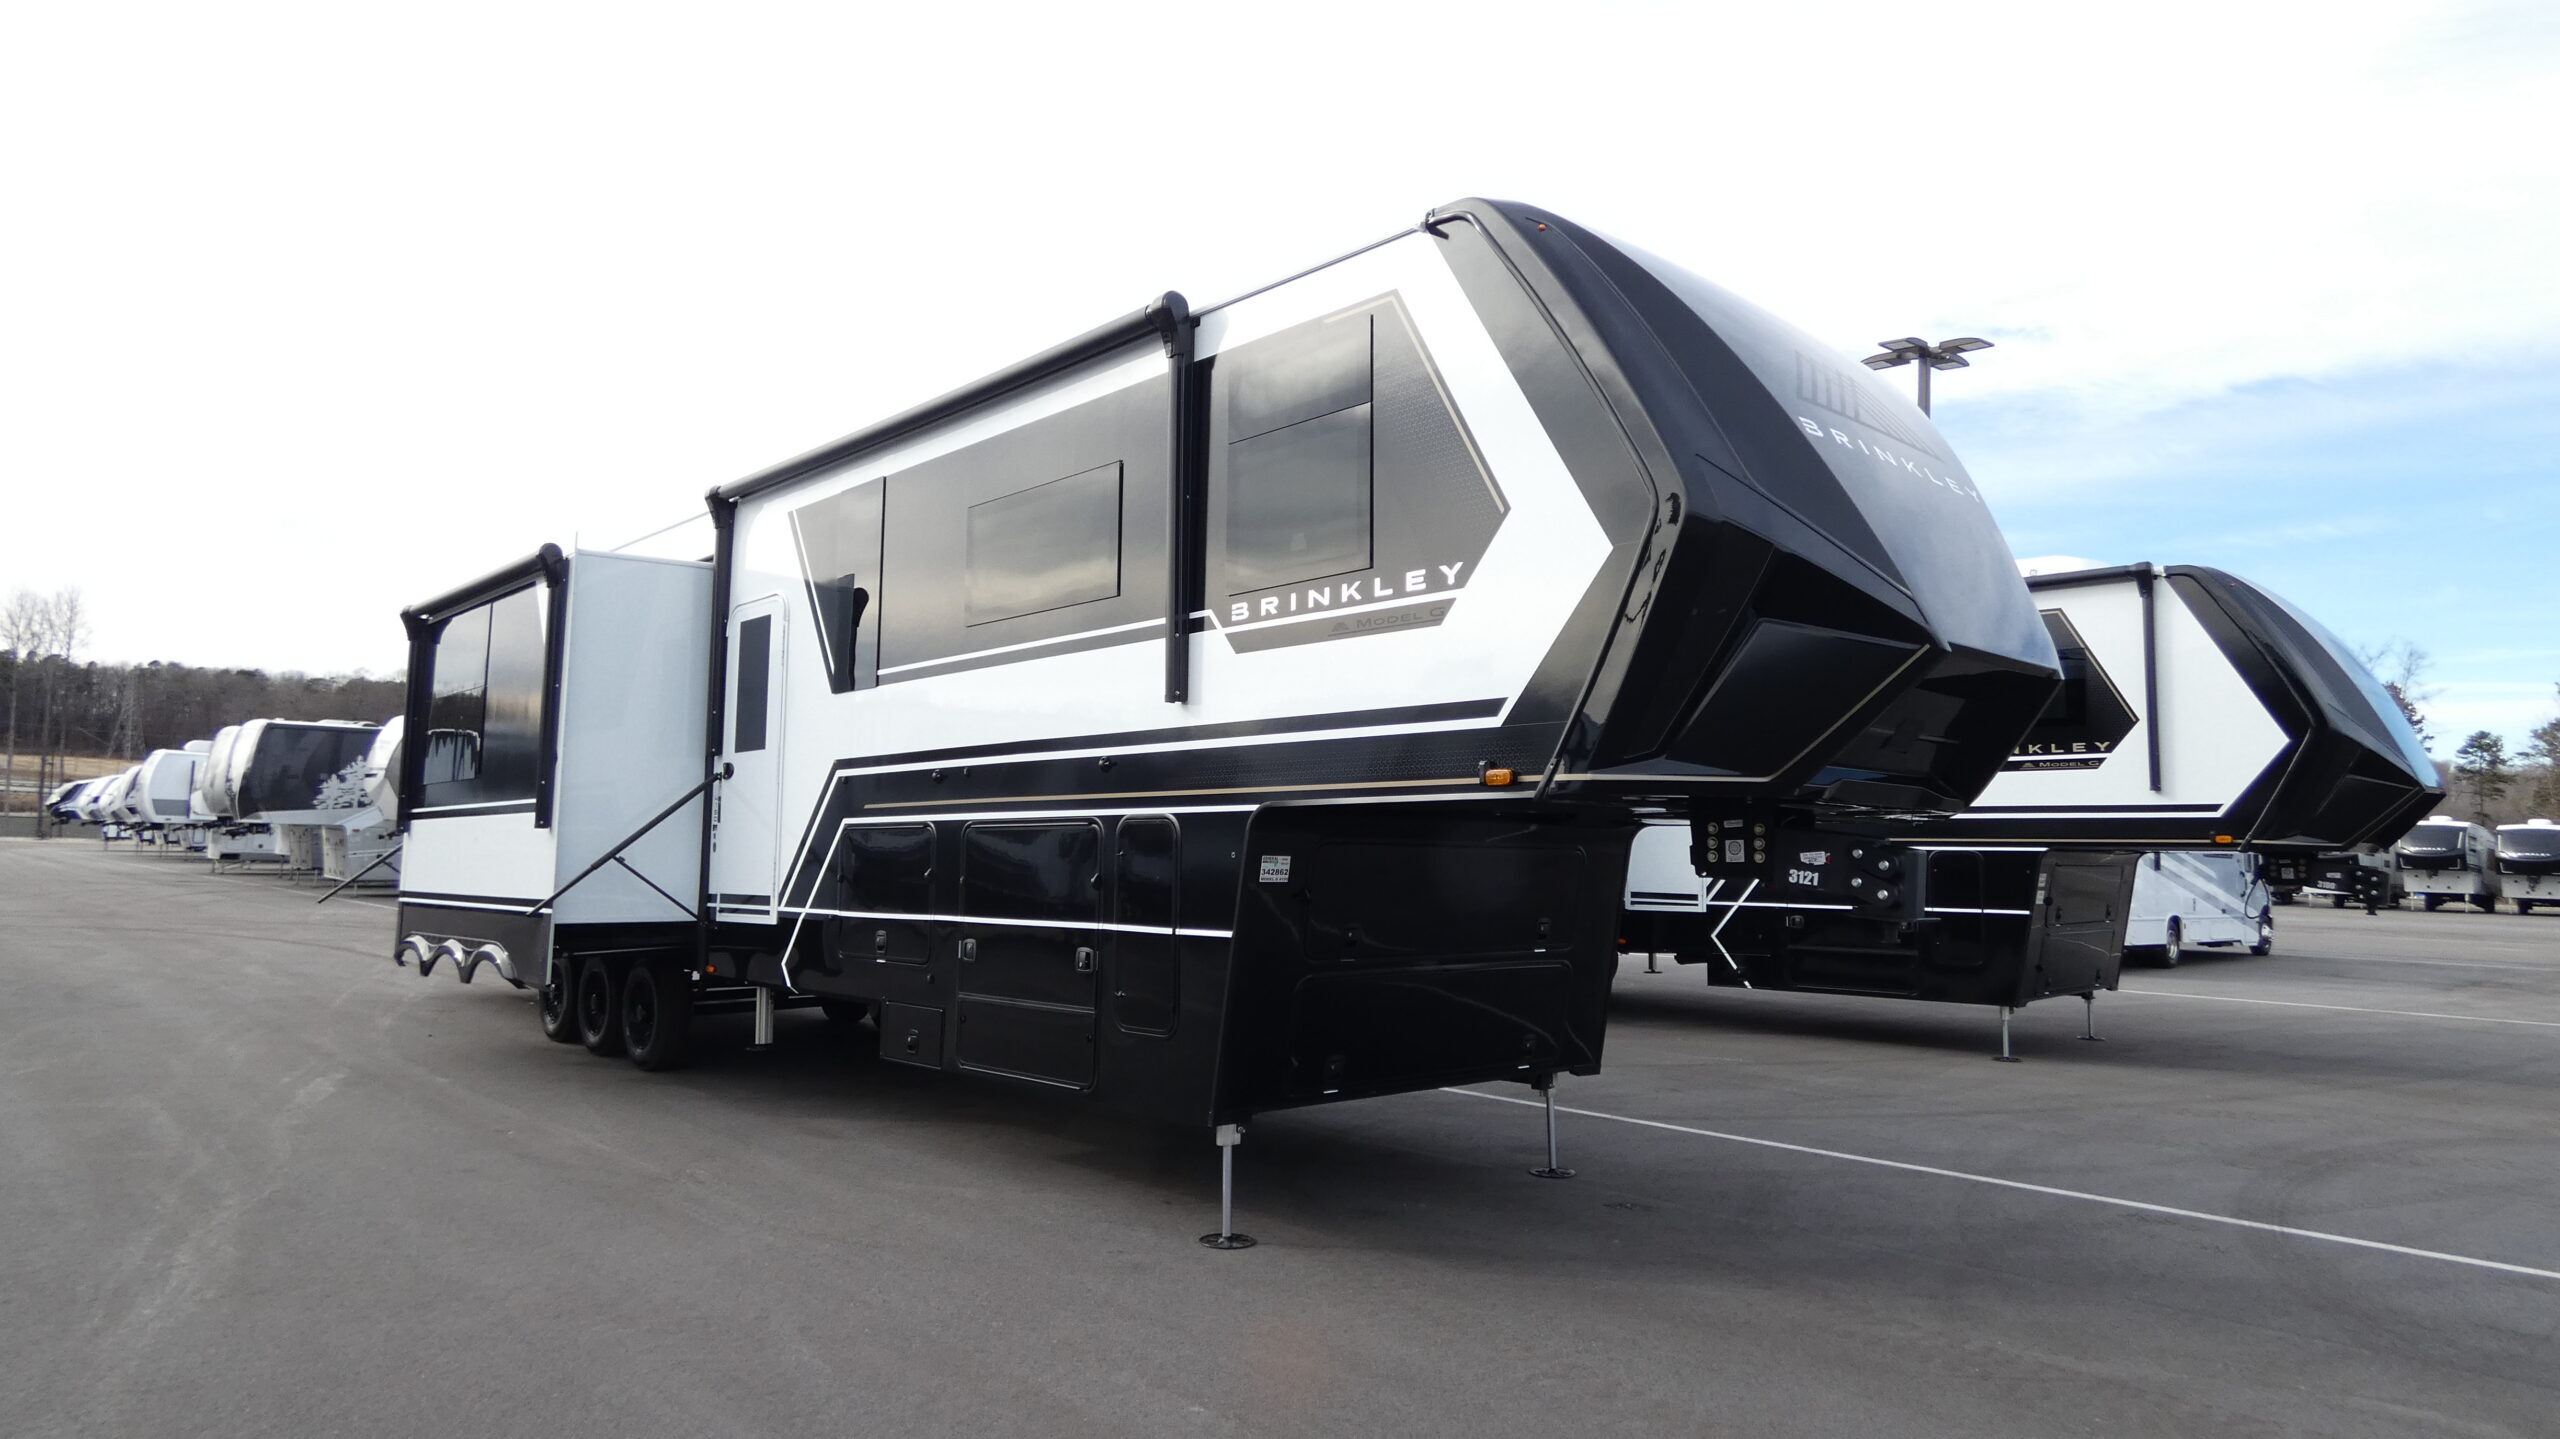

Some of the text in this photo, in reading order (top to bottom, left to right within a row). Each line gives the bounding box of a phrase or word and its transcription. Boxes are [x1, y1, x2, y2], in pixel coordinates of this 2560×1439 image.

[1798, 416, 1980, 503] BRINKLEY
[1231, 562, 1464, 622] BRINKLEY
[1261, 868, 1288, 876] 342862
[1788, 868, 1819, 886] 3121
